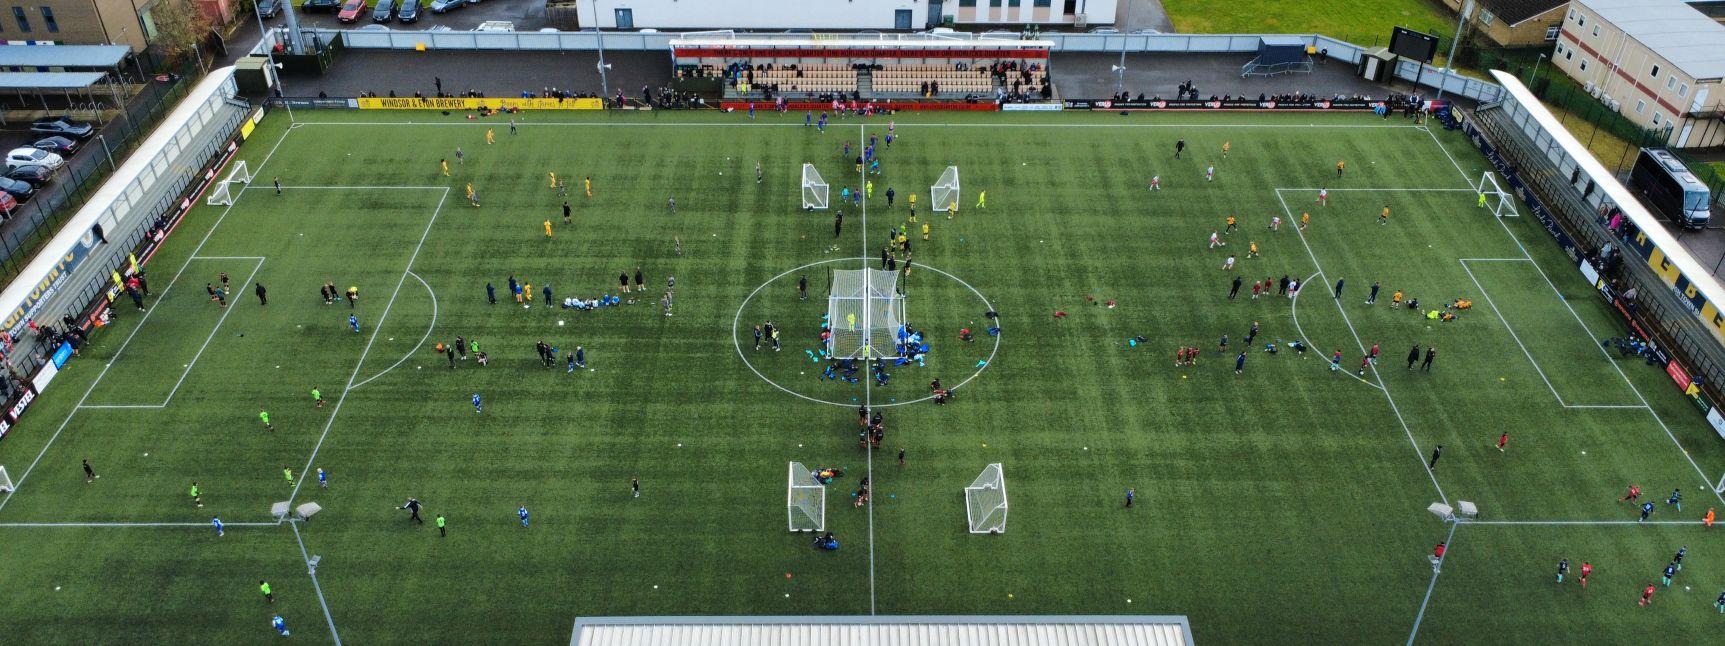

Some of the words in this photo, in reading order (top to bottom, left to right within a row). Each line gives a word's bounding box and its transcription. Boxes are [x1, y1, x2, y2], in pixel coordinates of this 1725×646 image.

[381, 99, 410, 107] WINDSOR
[411, 99, 417, 107] &
[437, 99, 465, 107] BREWERY
[24, 286, 55, 321] SUPPORTERS
[53, 271, 67, 290] TRUST
[9, 389, 35, 419] VESTEL
